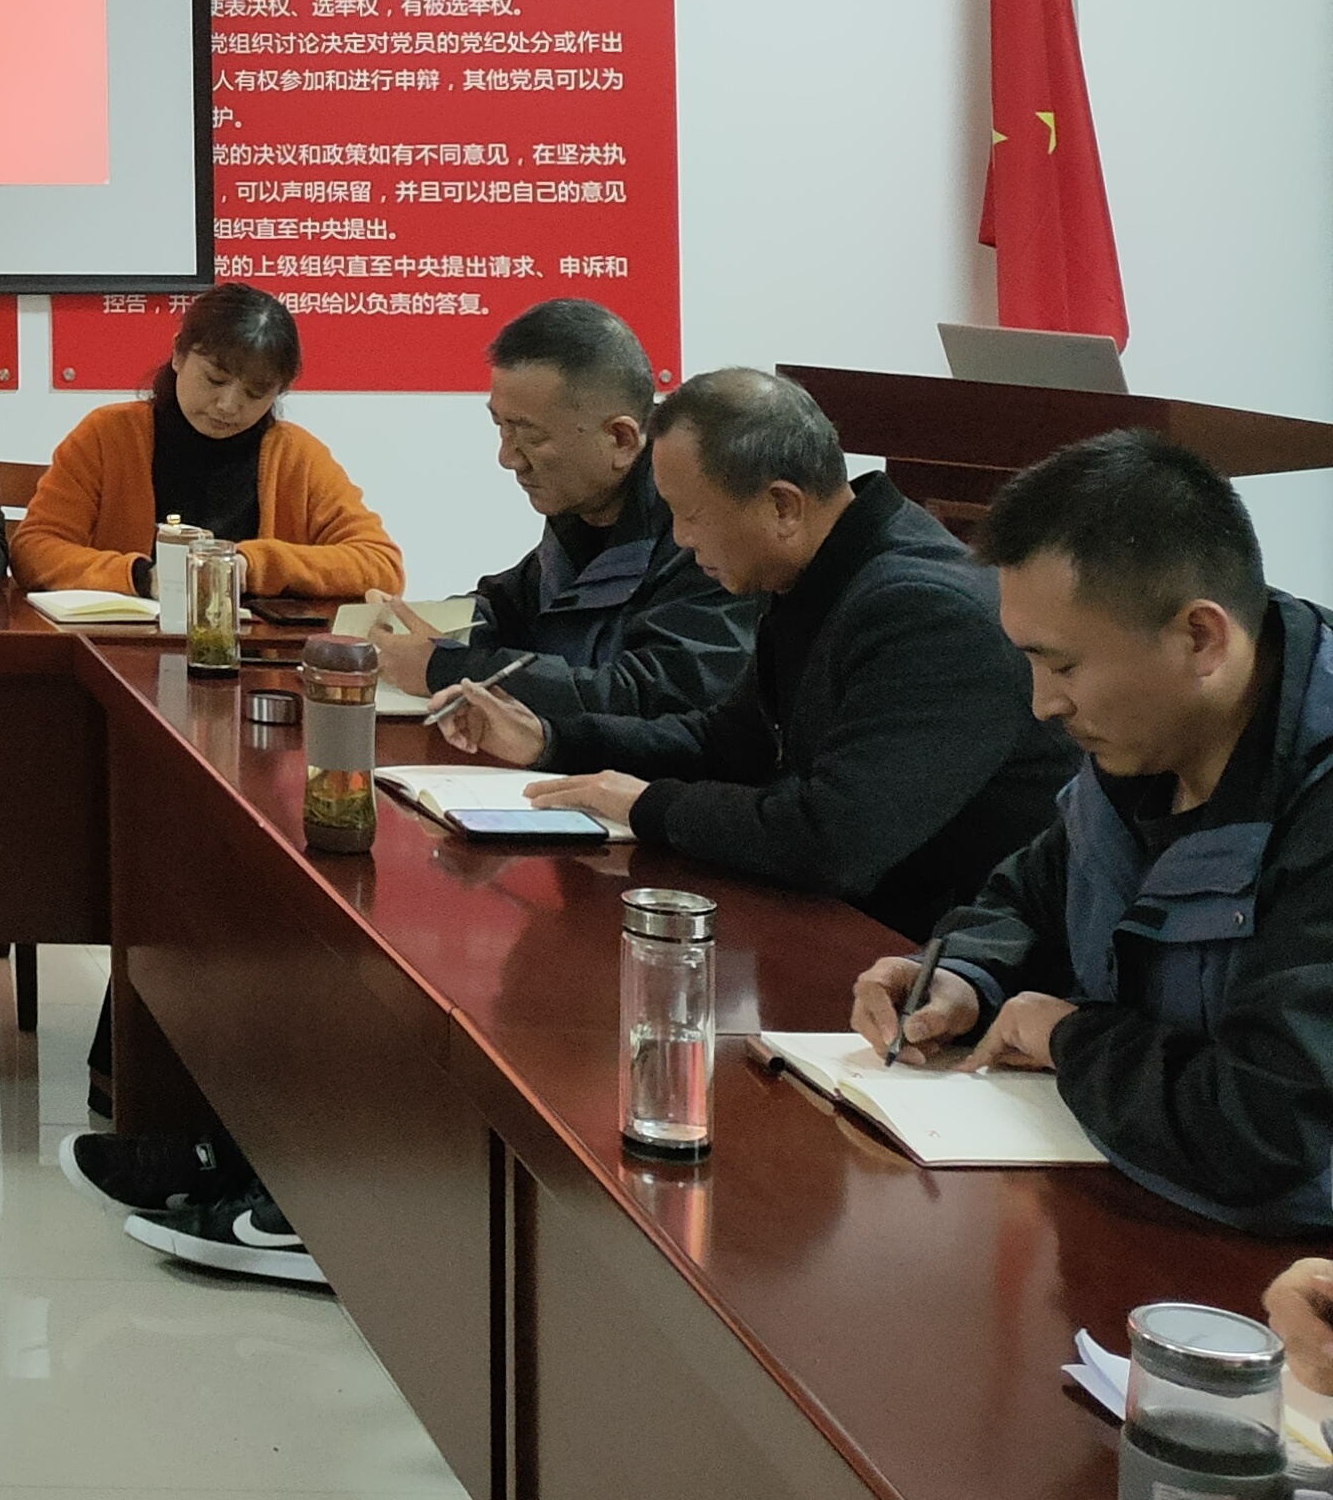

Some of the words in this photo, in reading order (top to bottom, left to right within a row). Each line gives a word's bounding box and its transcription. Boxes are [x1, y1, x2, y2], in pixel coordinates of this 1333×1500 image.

[275, 292, 490, 315] 组织给以负责的答复。
